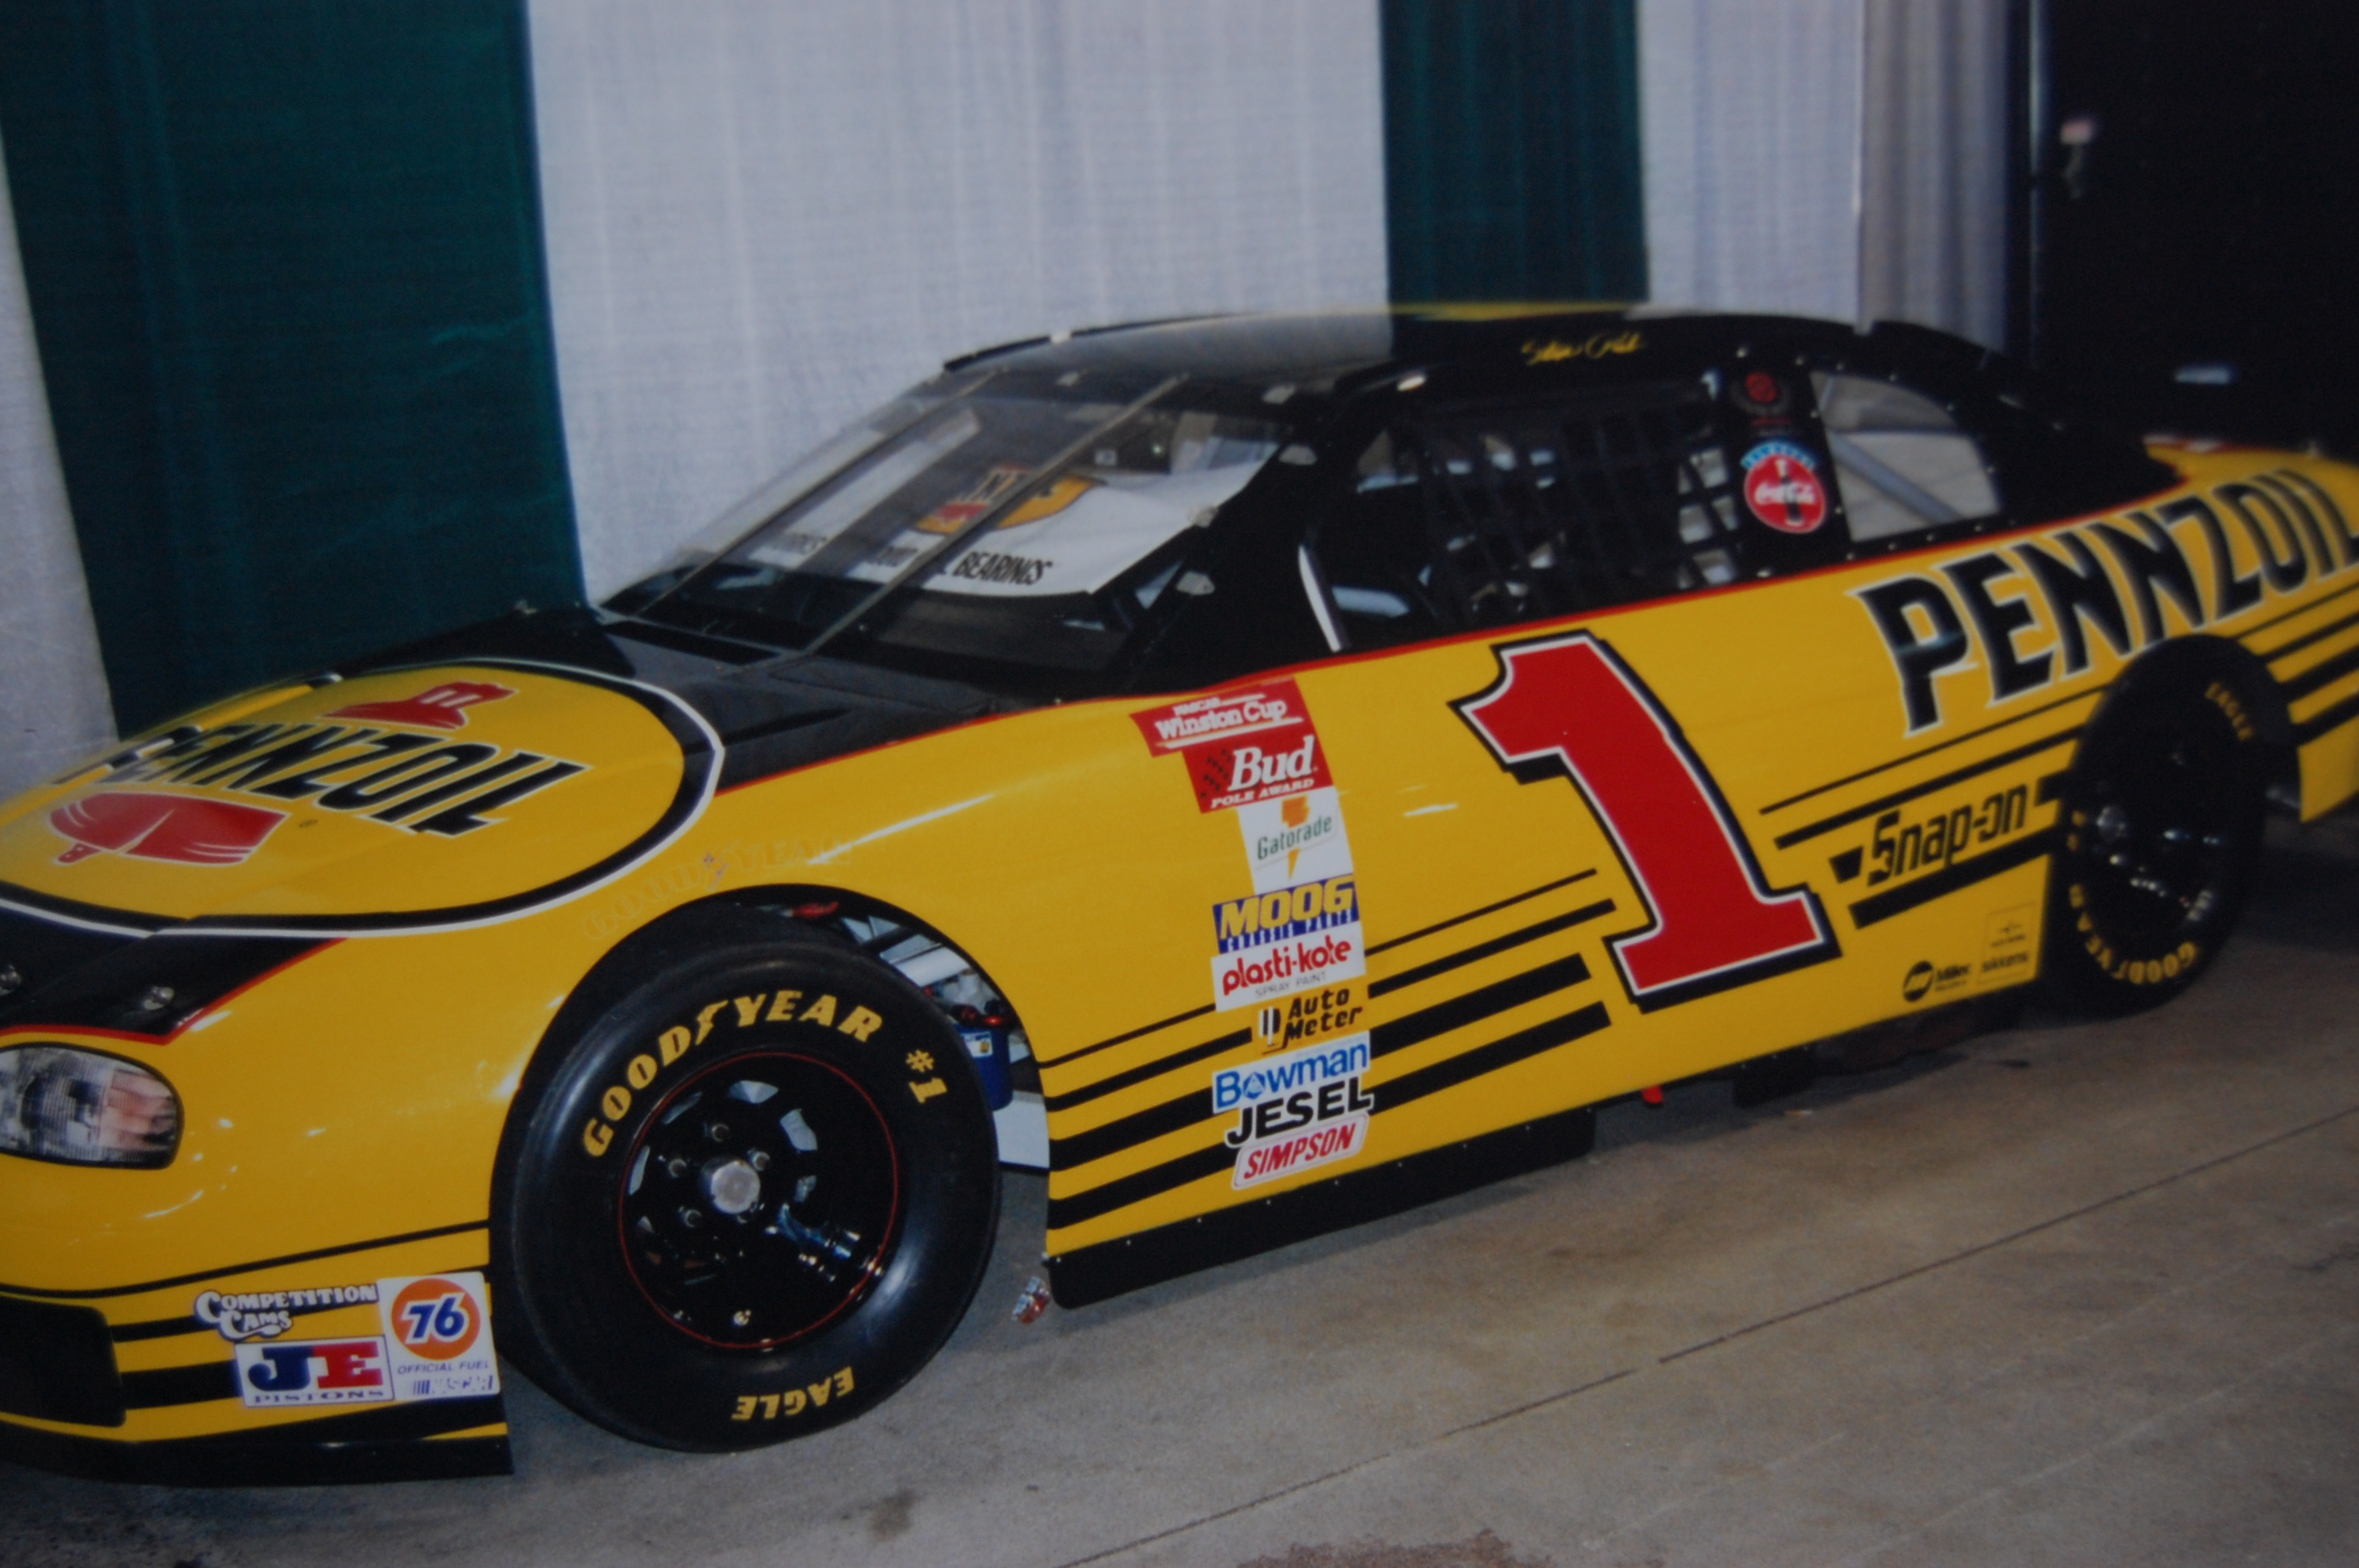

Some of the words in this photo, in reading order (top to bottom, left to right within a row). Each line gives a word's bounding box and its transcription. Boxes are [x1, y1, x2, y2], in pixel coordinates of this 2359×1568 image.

[1154, 708, 1244, 740] Winston
[1243, 699, 1288, 723] Cup
[1227, 734, 1315, 792] Bud
[1210, 790, 1255, 809] POLE
[1258, 778, 1314, 800] AWARD
[1256, 815, 1332, 860] Gatorade
[1446, 628, 1843, 1014] 1
[1866, 784, 2028, 887] Snap-on
[1219, 879, 1354, 940] MOOG
[1222, 935, 1351, 996] plasti-kote
[1256, 982, 1290, 998] SPRAY
[1296, 971, 1326, 985] PAINT
[1278, 1006, 1363, 1051] Meter
[1289, 989, 1350, 1020] Auto
[582, 989, 885, 1158] GOODYEAR
[1216, 1043, 1369, 1109] Bowman
[1227, 1076, 1372, 1145] JESEL
[1244, 1122, 1357, 1180] SIMPSON
[405, 1294, 467, 1343] 76
[248, 1341, 383, 1392] JE
[397, 1363, 453, 1374] OFFICIAL
[459, 1360, 490, 1370] FUEL
[255, 1390, 384, 1404] PISTONS
[731, 1367, 855, 1422] EAGLE
